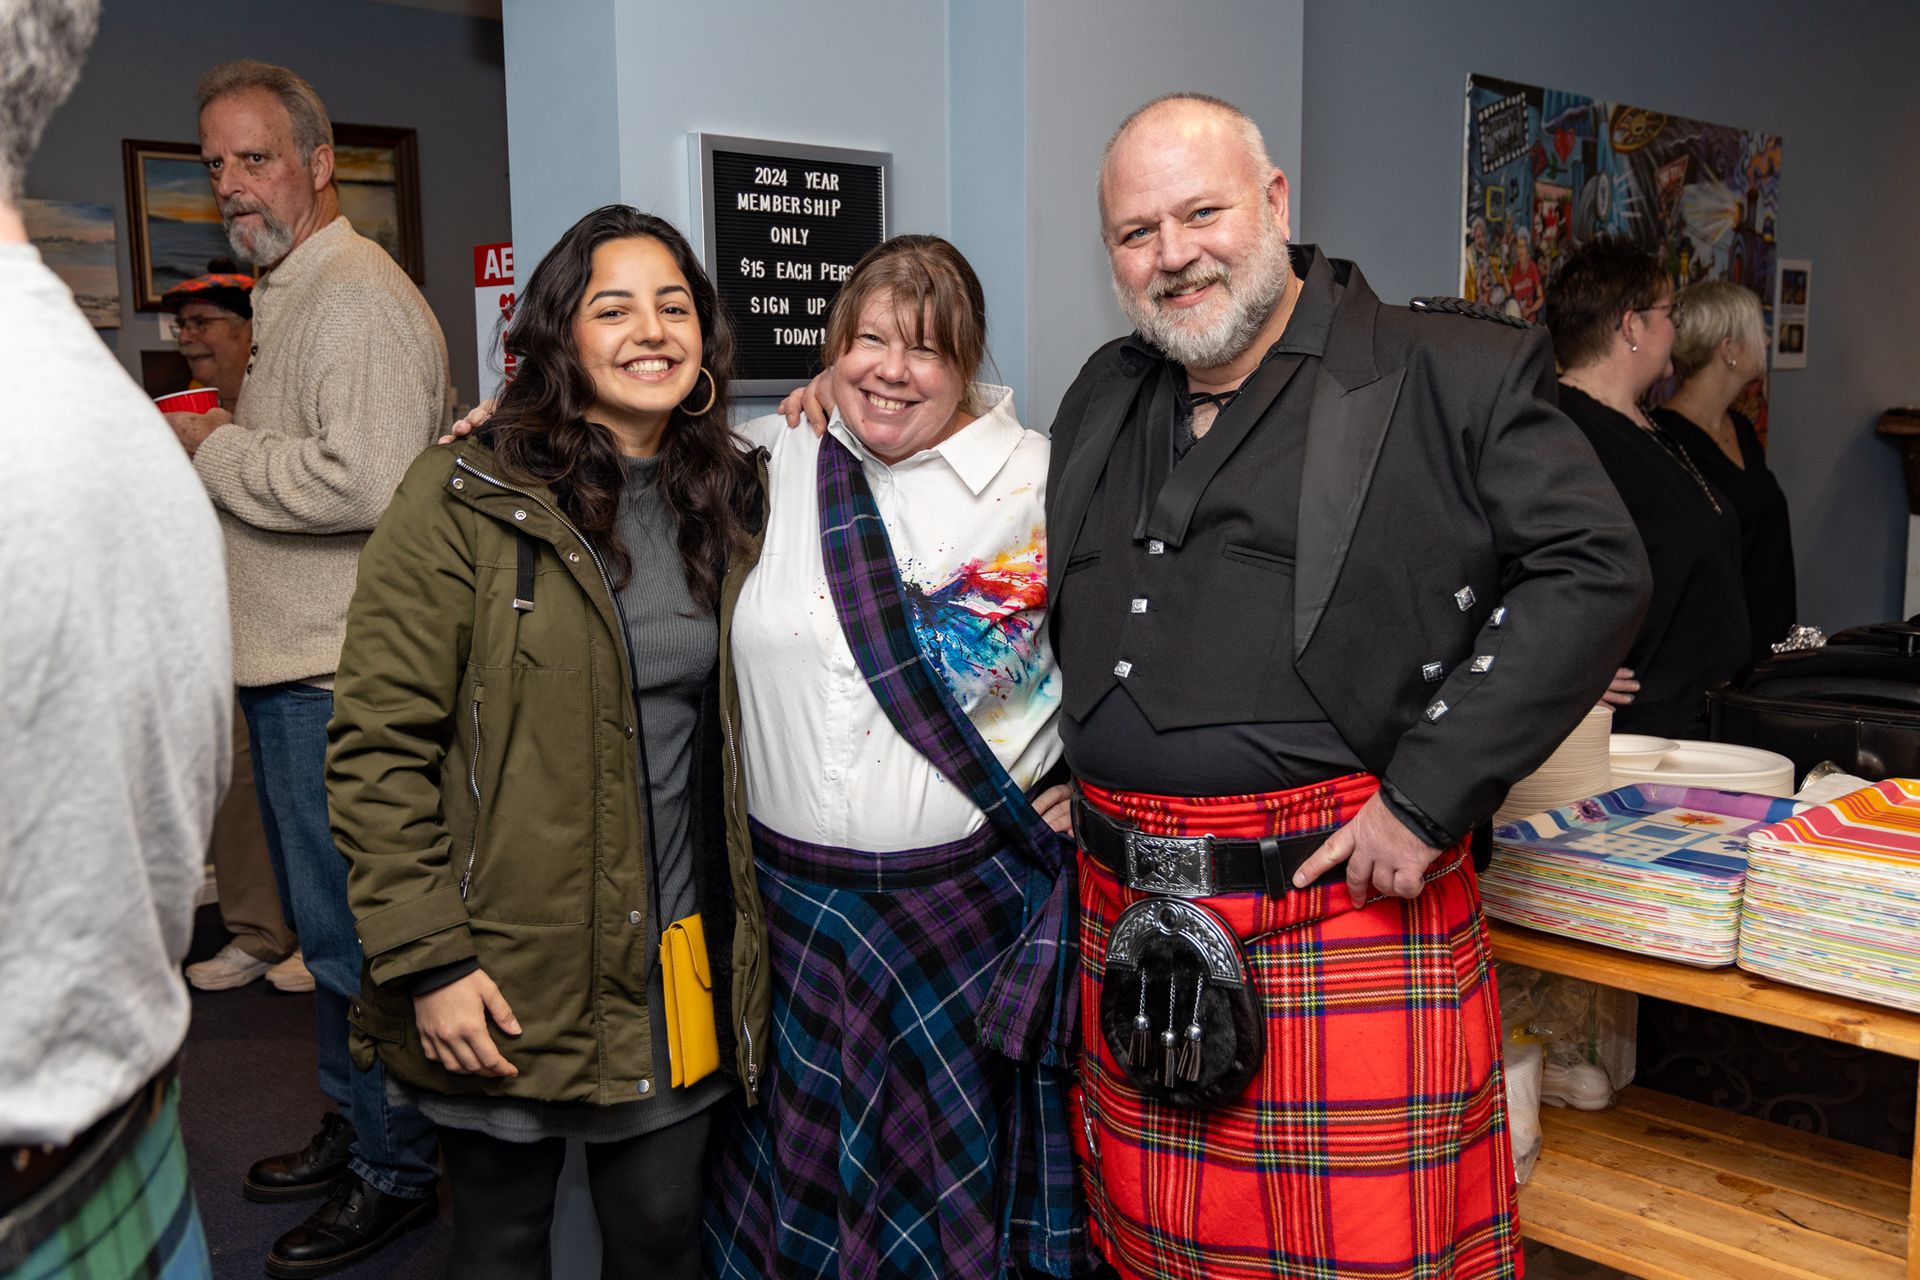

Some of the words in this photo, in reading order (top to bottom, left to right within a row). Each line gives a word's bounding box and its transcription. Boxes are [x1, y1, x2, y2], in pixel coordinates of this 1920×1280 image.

[754, 166, 788, 187] 2024
[804, 171, 840, 191] YEAR
[736, 192, 842, 217] MEMBERSHIP
[770, 226, 809, 246] ONLY
[740, 257, 766, 278] $15
[776, 261, 812, 280] EACH
[750, 295, 790, 316] SIGN
[807, 297, 827, 316] UP
[773, 327, 826, 346] TODAY!
